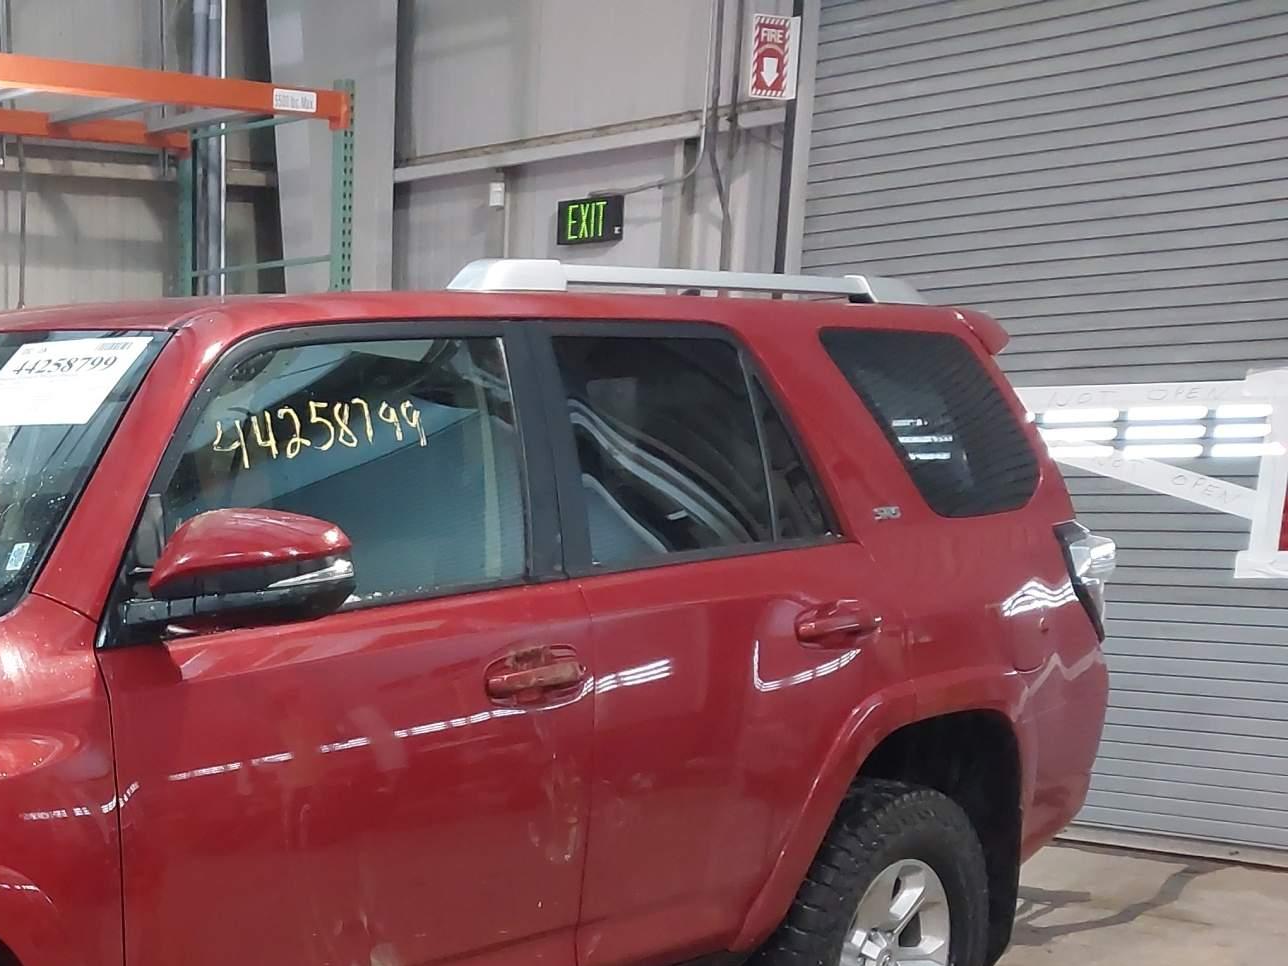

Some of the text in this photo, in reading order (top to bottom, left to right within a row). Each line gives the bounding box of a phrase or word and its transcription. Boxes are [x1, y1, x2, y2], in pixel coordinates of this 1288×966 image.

[760, 27, 785, 43] FIRE
[567, 201, 608, 240] EXIT
[13, 356, 118, 375] 44258799
[213, 398, 428, 469] 44258799
